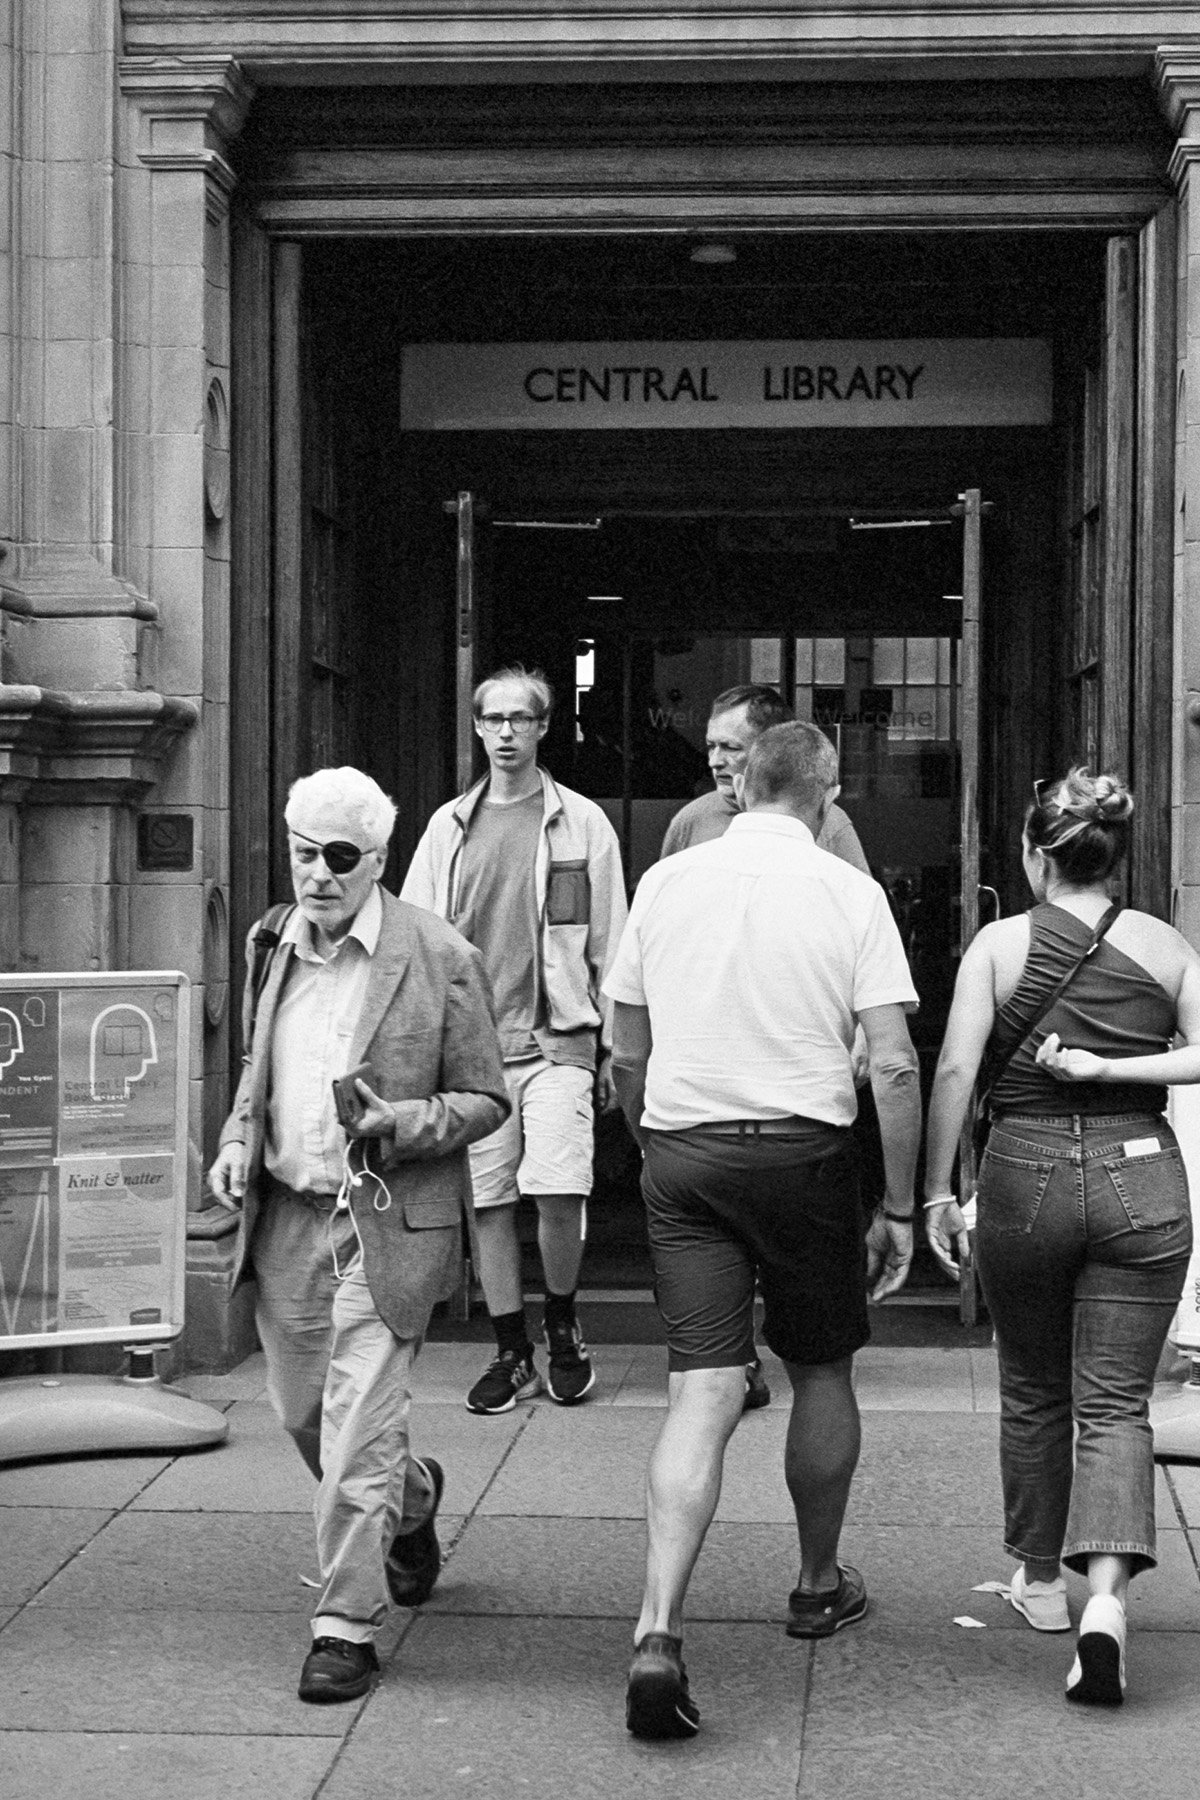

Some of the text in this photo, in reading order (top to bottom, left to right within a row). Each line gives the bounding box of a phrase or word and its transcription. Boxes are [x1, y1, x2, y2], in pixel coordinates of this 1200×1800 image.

[522, 362, 926, 403] CENTRAL LIBRARY
[647, 706, 706, 728] Welc
[813, 706, 933, 729] Welcome
[67, 1173, 99, 1189] Knit
[104, 1171, 121, 1188] &
[122, 1171, 164, 1187] natter
